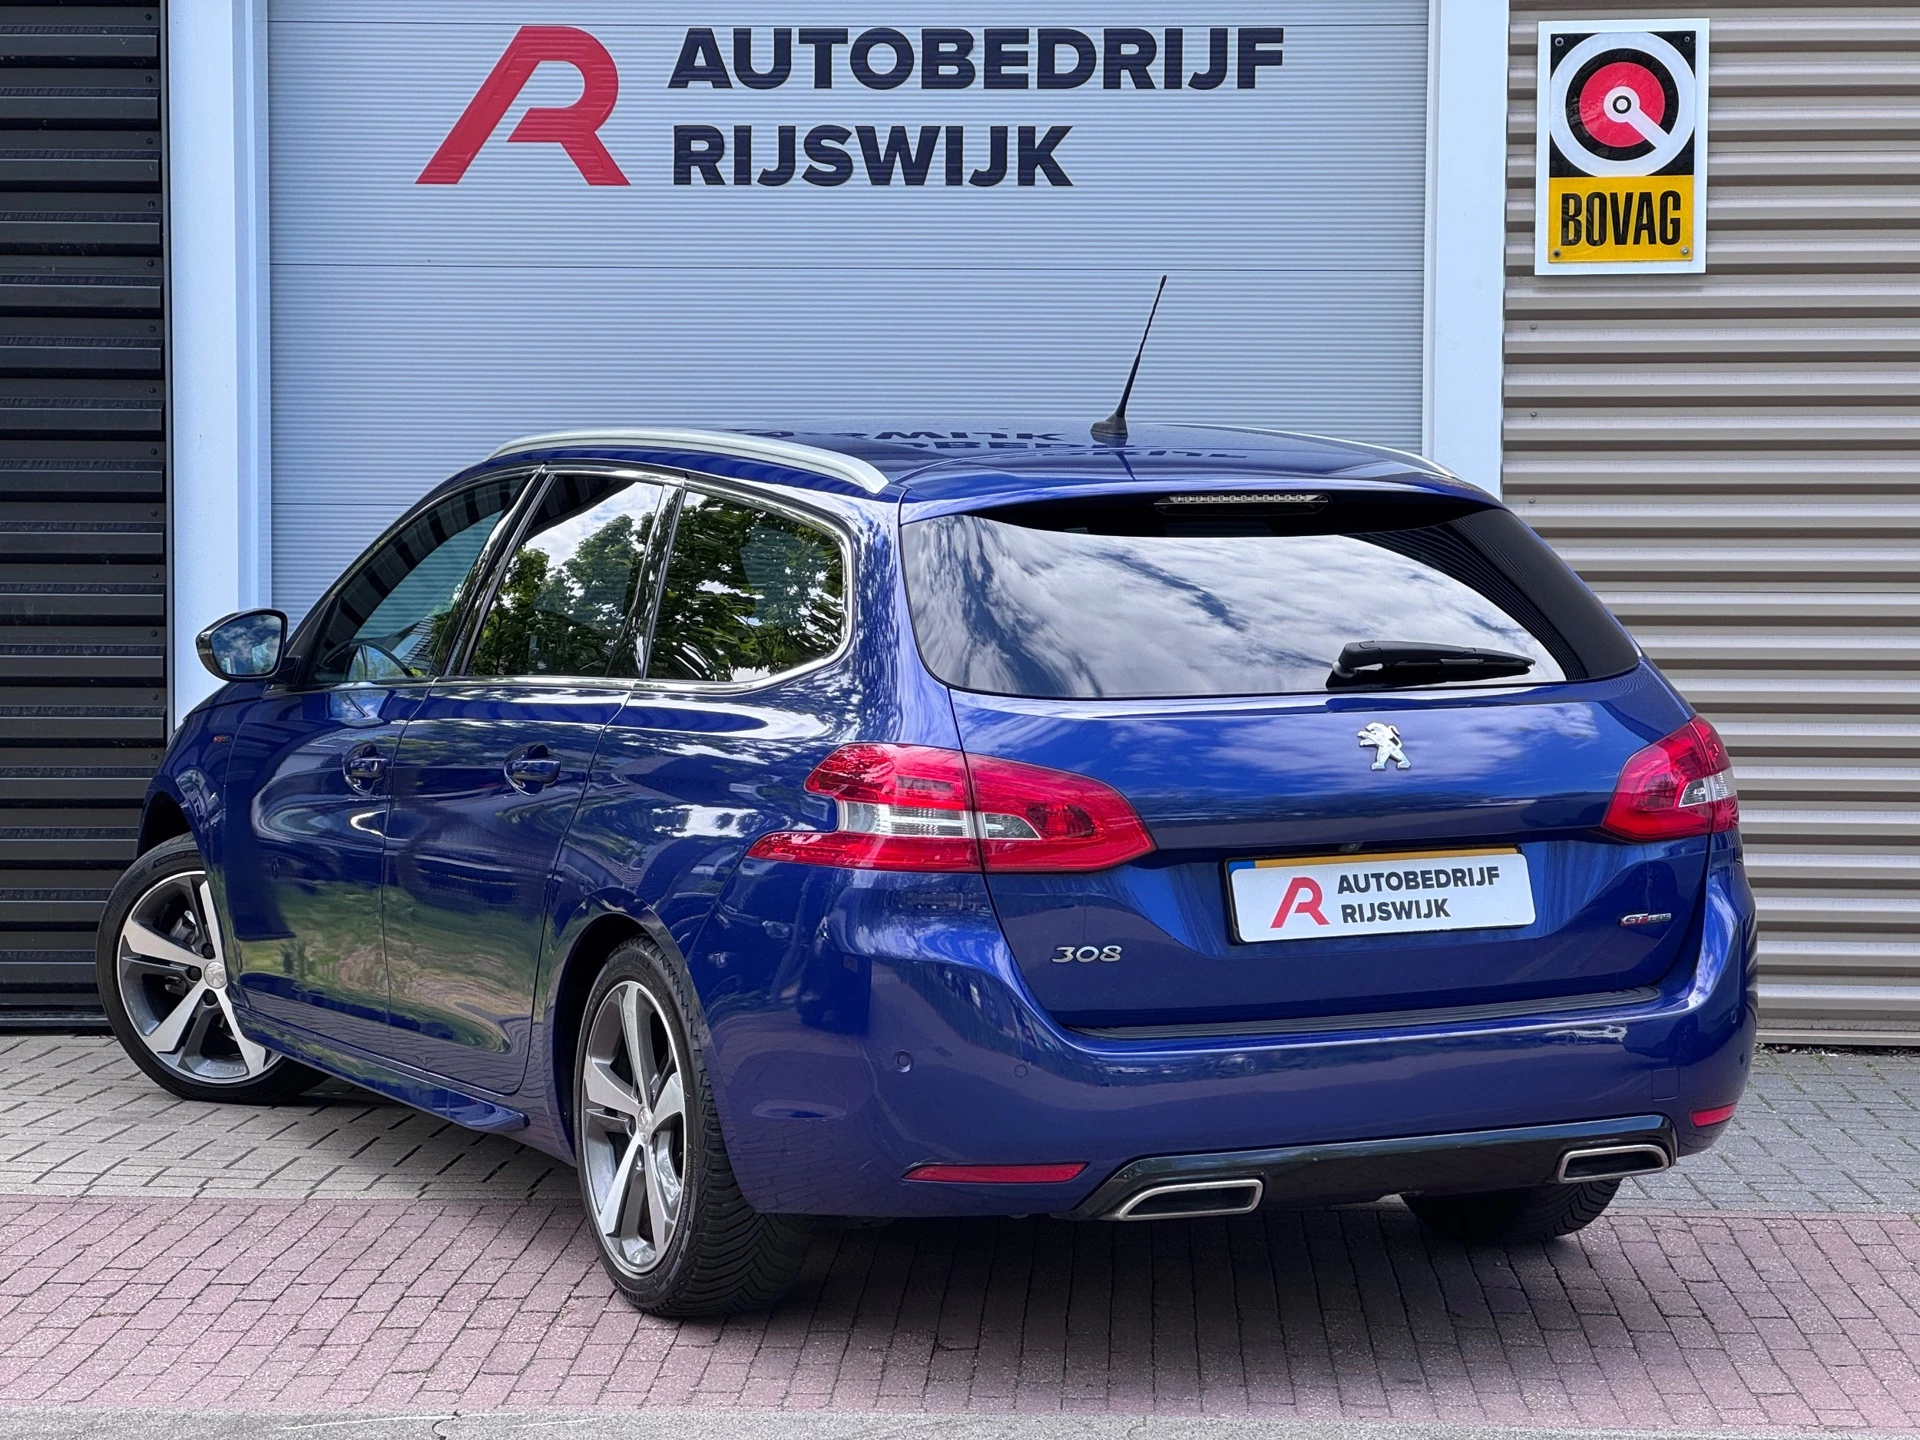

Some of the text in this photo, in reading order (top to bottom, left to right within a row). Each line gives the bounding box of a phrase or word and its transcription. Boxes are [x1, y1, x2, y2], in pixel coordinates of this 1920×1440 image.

[668, 27, 1284, 90] AUTOBEDRIJF
[673, 124, 1073, 188] RIJSWIJK
[1560, 190, 1682, 247] BOVAG
[1338, 866, 1500, 894] AUTOBEDRIJF
[1341, 898, 1451, 923] RIJSWIJK
[1051, 945, 1122, 963] 308
